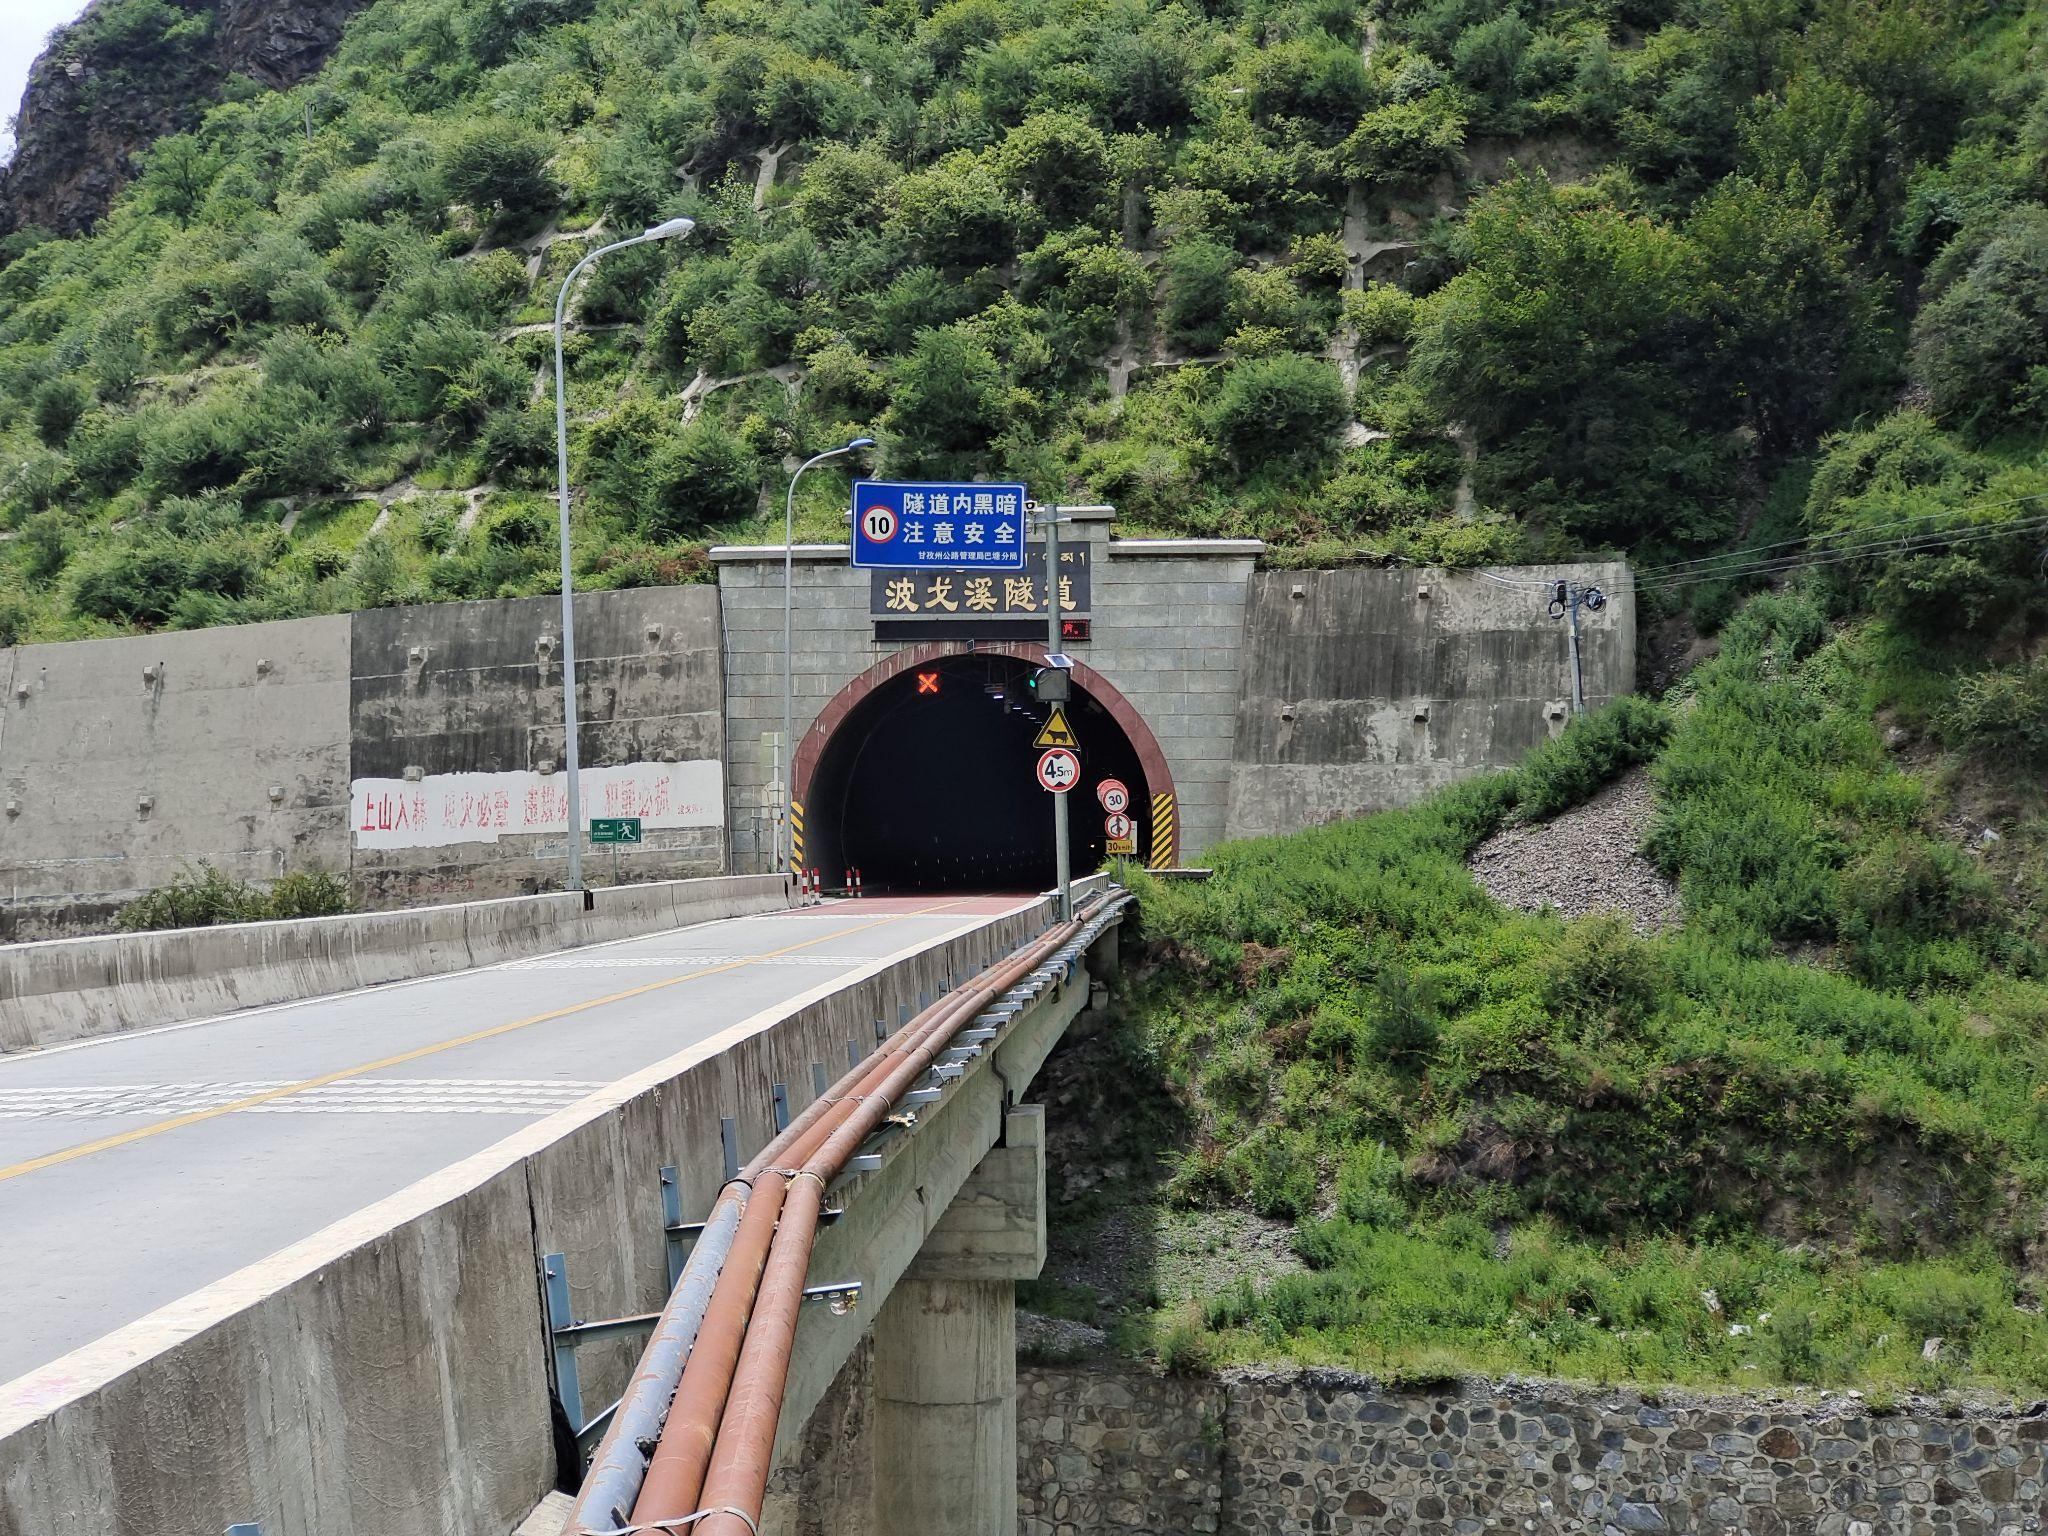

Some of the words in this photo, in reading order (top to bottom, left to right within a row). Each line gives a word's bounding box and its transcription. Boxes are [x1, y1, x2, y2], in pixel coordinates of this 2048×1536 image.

[903, 492, 1017, 516] 隧道内黑暗
[869, 516, 890, 535] 10
[903, 521, 1016, 545] 注意安全
[918, 551, 1018, 561] 甘孜州公路管理局巴塘分局
[1044, 759, 1073, 779] 4.5m
[1108, 794, 1122, 806] 30
